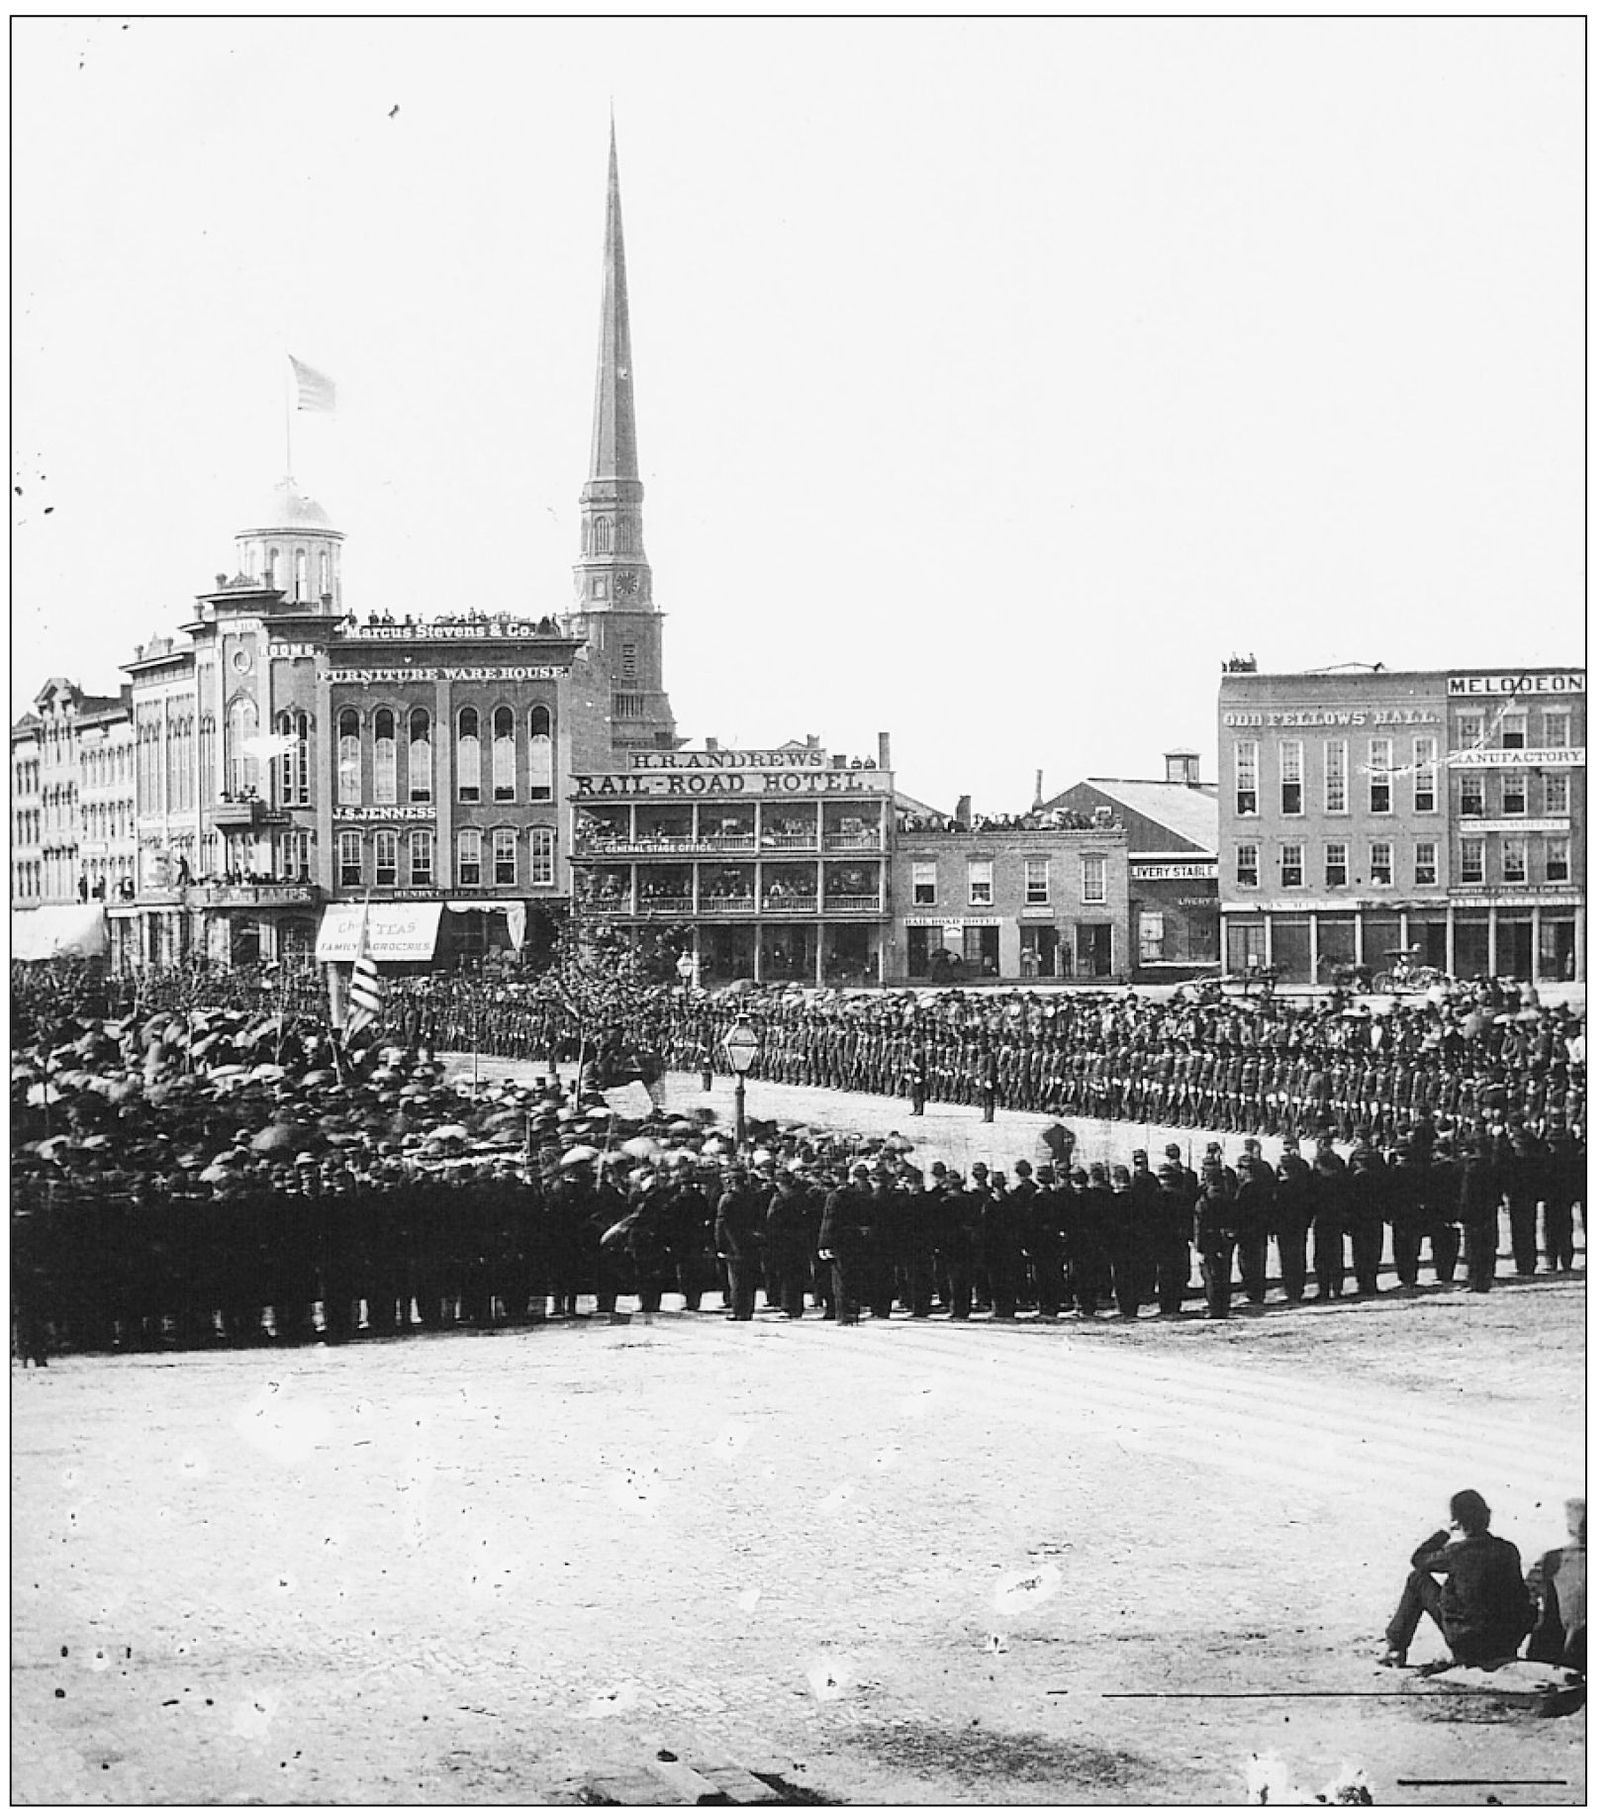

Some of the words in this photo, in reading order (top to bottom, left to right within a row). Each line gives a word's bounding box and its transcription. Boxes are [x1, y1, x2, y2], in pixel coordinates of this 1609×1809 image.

[345, 625, 411, 638] Marcus
[416, 624, 484, 638] Stevens
[490, 625, 501, 637] &
[507, 623, 535, 637] Co.
[317, 669, 438, 681] FURNITURE
[444, 668, 496, 680] WARE
[1451, 678, 1583, 692] MELODEON
[1224, 711, 1263, 726] ODD
[1375, 709, 1441, 723] HALL.
[1131, 866, 1169, 877] LIVERY
[376, 922, 416, 935] TEAS
[320, 943, 358, 951] FAMILY
